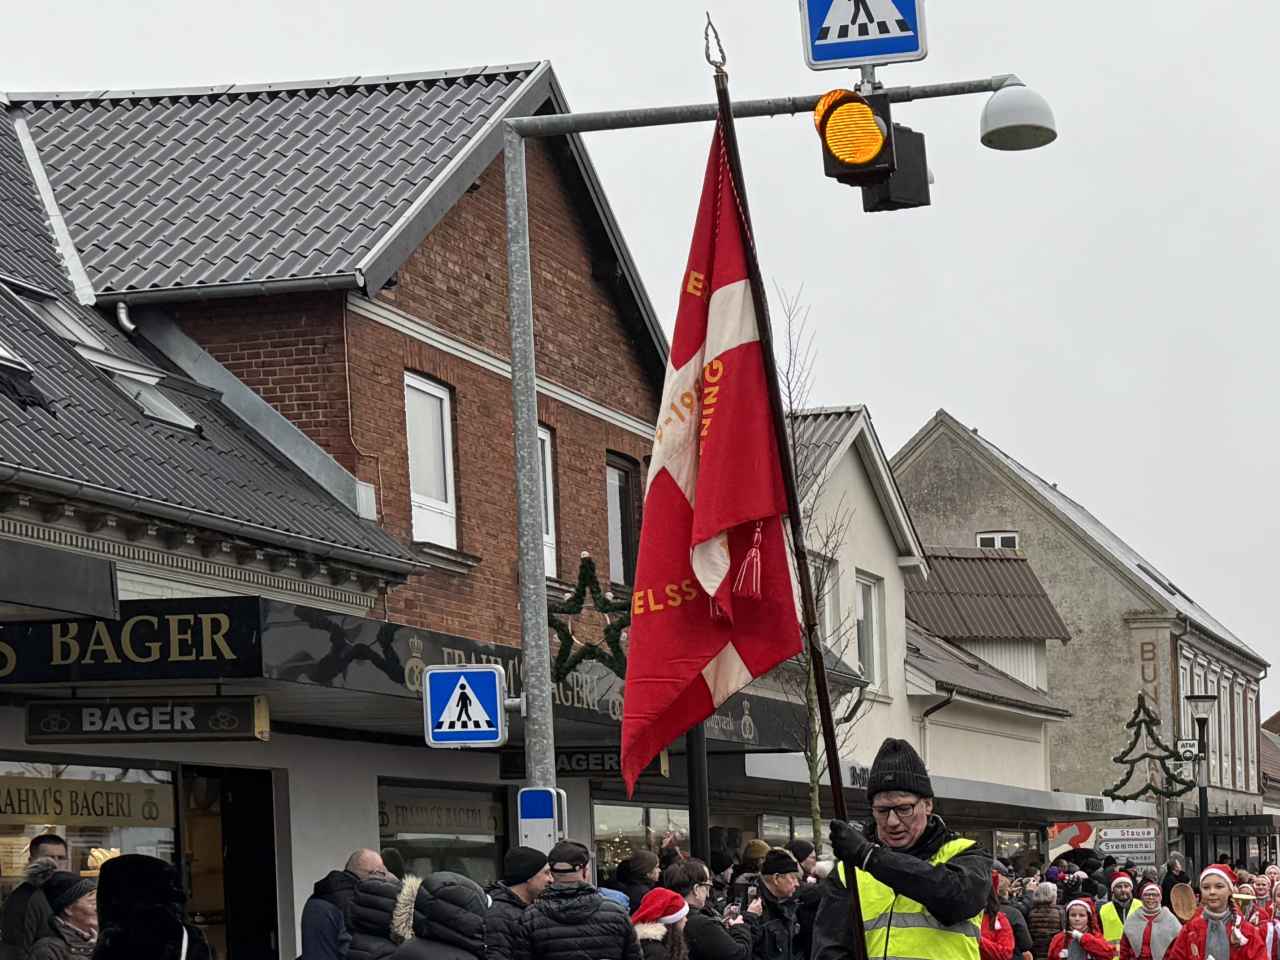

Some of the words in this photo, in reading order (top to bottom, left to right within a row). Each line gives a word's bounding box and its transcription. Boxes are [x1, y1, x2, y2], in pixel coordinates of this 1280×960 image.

[50, 613, 238, 666] BAGER
[81, 706, 196, 732] BAGER
[556, 753, 620, 770] AGER
[70, 789, 132, 817] BAGERI
